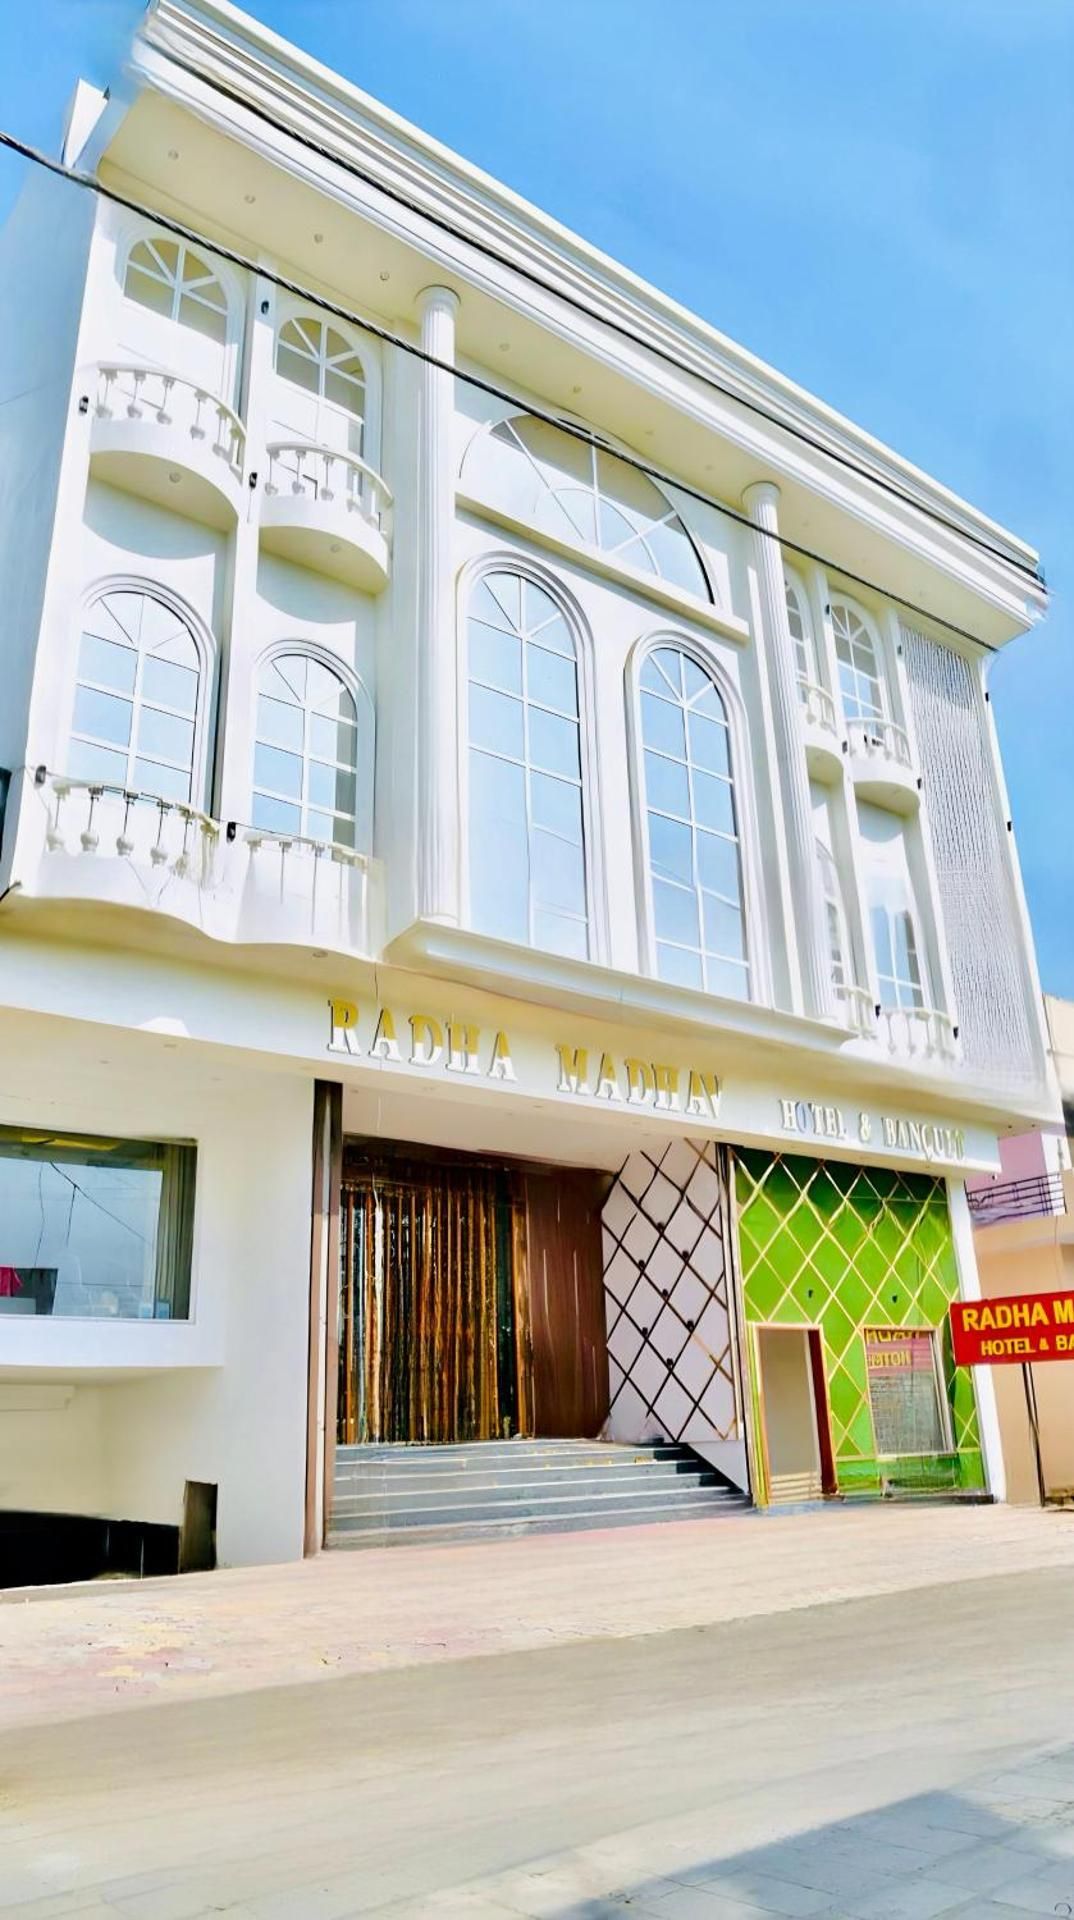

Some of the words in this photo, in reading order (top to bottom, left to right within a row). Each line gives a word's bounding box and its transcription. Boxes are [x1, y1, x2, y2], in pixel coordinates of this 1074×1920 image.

[327, 998, 517, 1082] RADHA
[555, 1043, 721, 1119] MADHAV
[779, 1099, 846, 1140] HOTEL
[859, 1112, 871, 1143] &
[962, 1302, 1049, 1331] RADHA
[981, 1338, 1036, 1356] HOTEL
